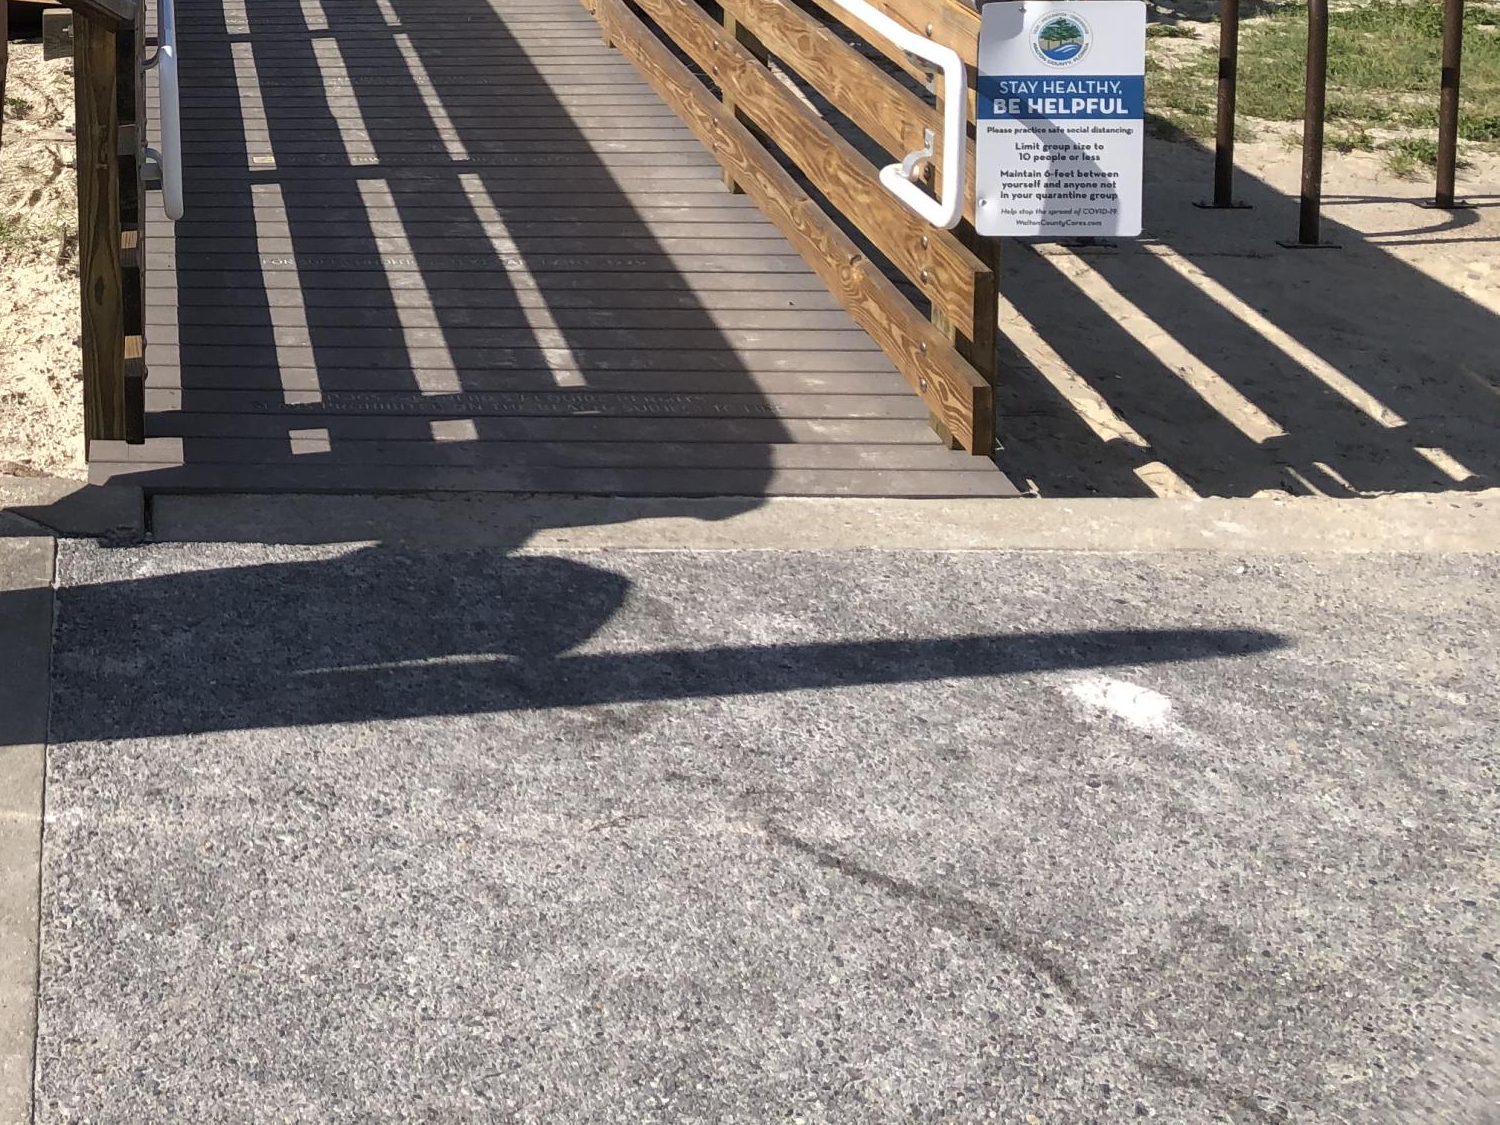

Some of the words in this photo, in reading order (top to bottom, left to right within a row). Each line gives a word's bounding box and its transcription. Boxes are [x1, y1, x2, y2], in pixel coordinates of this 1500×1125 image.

[1000, 81, 1038, 94] STAY
[1043, 81, 1122, 95] HEALTHY,
[994, 99, 1020, 114] BE
[1028, 98, 1128, 114] HELPFUL
[1034, 153, 1066, 162] people
[1082, 152, 1100, 161] less
[1044, 169, 1074, 177] 6-feet
[1077, 170, 1118, 178] between
[1002, 180, 1040, 190] yourself
[1036, 192, 1087, 200] quarantine
